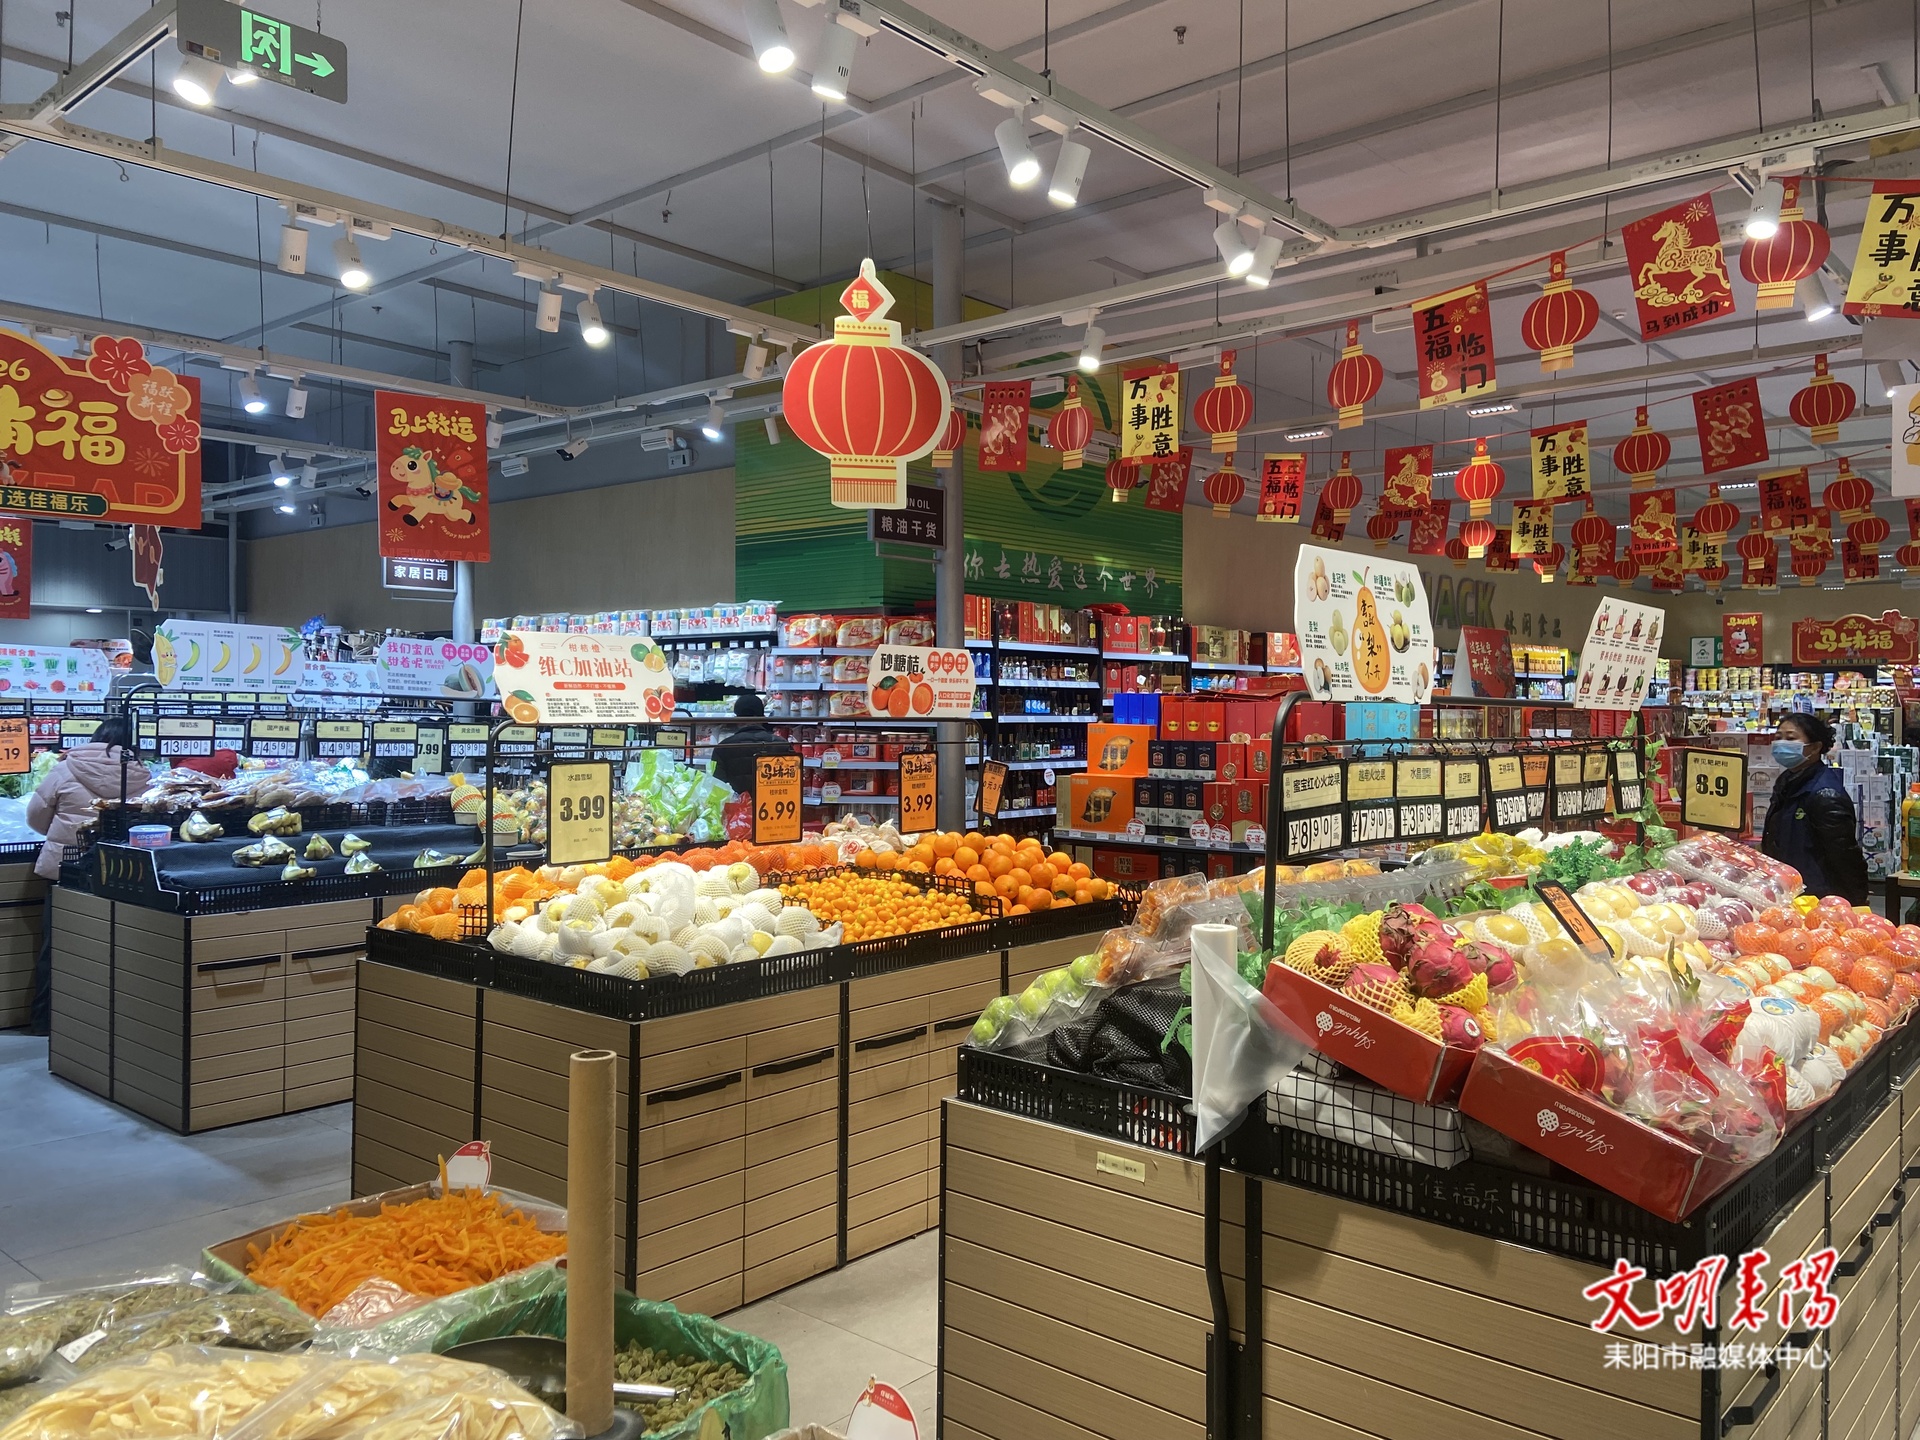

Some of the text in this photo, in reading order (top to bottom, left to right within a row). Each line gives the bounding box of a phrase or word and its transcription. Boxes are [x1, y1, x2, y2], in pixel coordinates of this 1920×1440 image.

[852, 289, 869, 309] 福
[1645, 300, 1719, 334] 马到成功
[1422, 303, 1453, 363] 五福
[1456, 332, 1487, 395] 临门
[1128, 378, 1150, 431] 万事
[388, 407, 478, 443] 马上转运
[1151, 406, 1174, 459] 胜意
[1537, 432, 1561, 477] 万事
[1266, 459, 1283, 495] 五福
[1562, 453, 1586, 499] 胜意
[0, 487, 89, 513] 选佳福乐
[916, 499, 931, 510] OIL
[1764, 480, 1785, 511] 五福
[881, 515, 937, 539] 粮油干货
[1383, 508, 1424, 520] 马到成功
[1516, 505, 1533, 538] 万事
[1787, 496, 1808, 531] 临门
[1532, 523, 1550, 556] 胜意
[394, 565, 449, 583] 家居日用
[1503, 609, 1562, 639] 休闲食品
[387, 642, 435, 657] 我们蜜瓜
[1814, 628, 1894, 653] 马上有福
[387, 656, 424, 670] 甜着呢
[538, 656, 634, 679] 维C加油站
[880, 653, 920, 676] 砂糖桔
[417, 743, 439, 755] 7.99
[1695, 773, 1729, 797] 8.9
[559, 795, 605, 823] 3.99
[758, 800, 796, 822] 6.99
[903, 793, 933, 813] 3.99
[1331, 1022, 1376, 1050] Apple
[1557, 1122, 1614, 1155] Apple
[1420, 1172, 1505, 1215] 佳福乐
